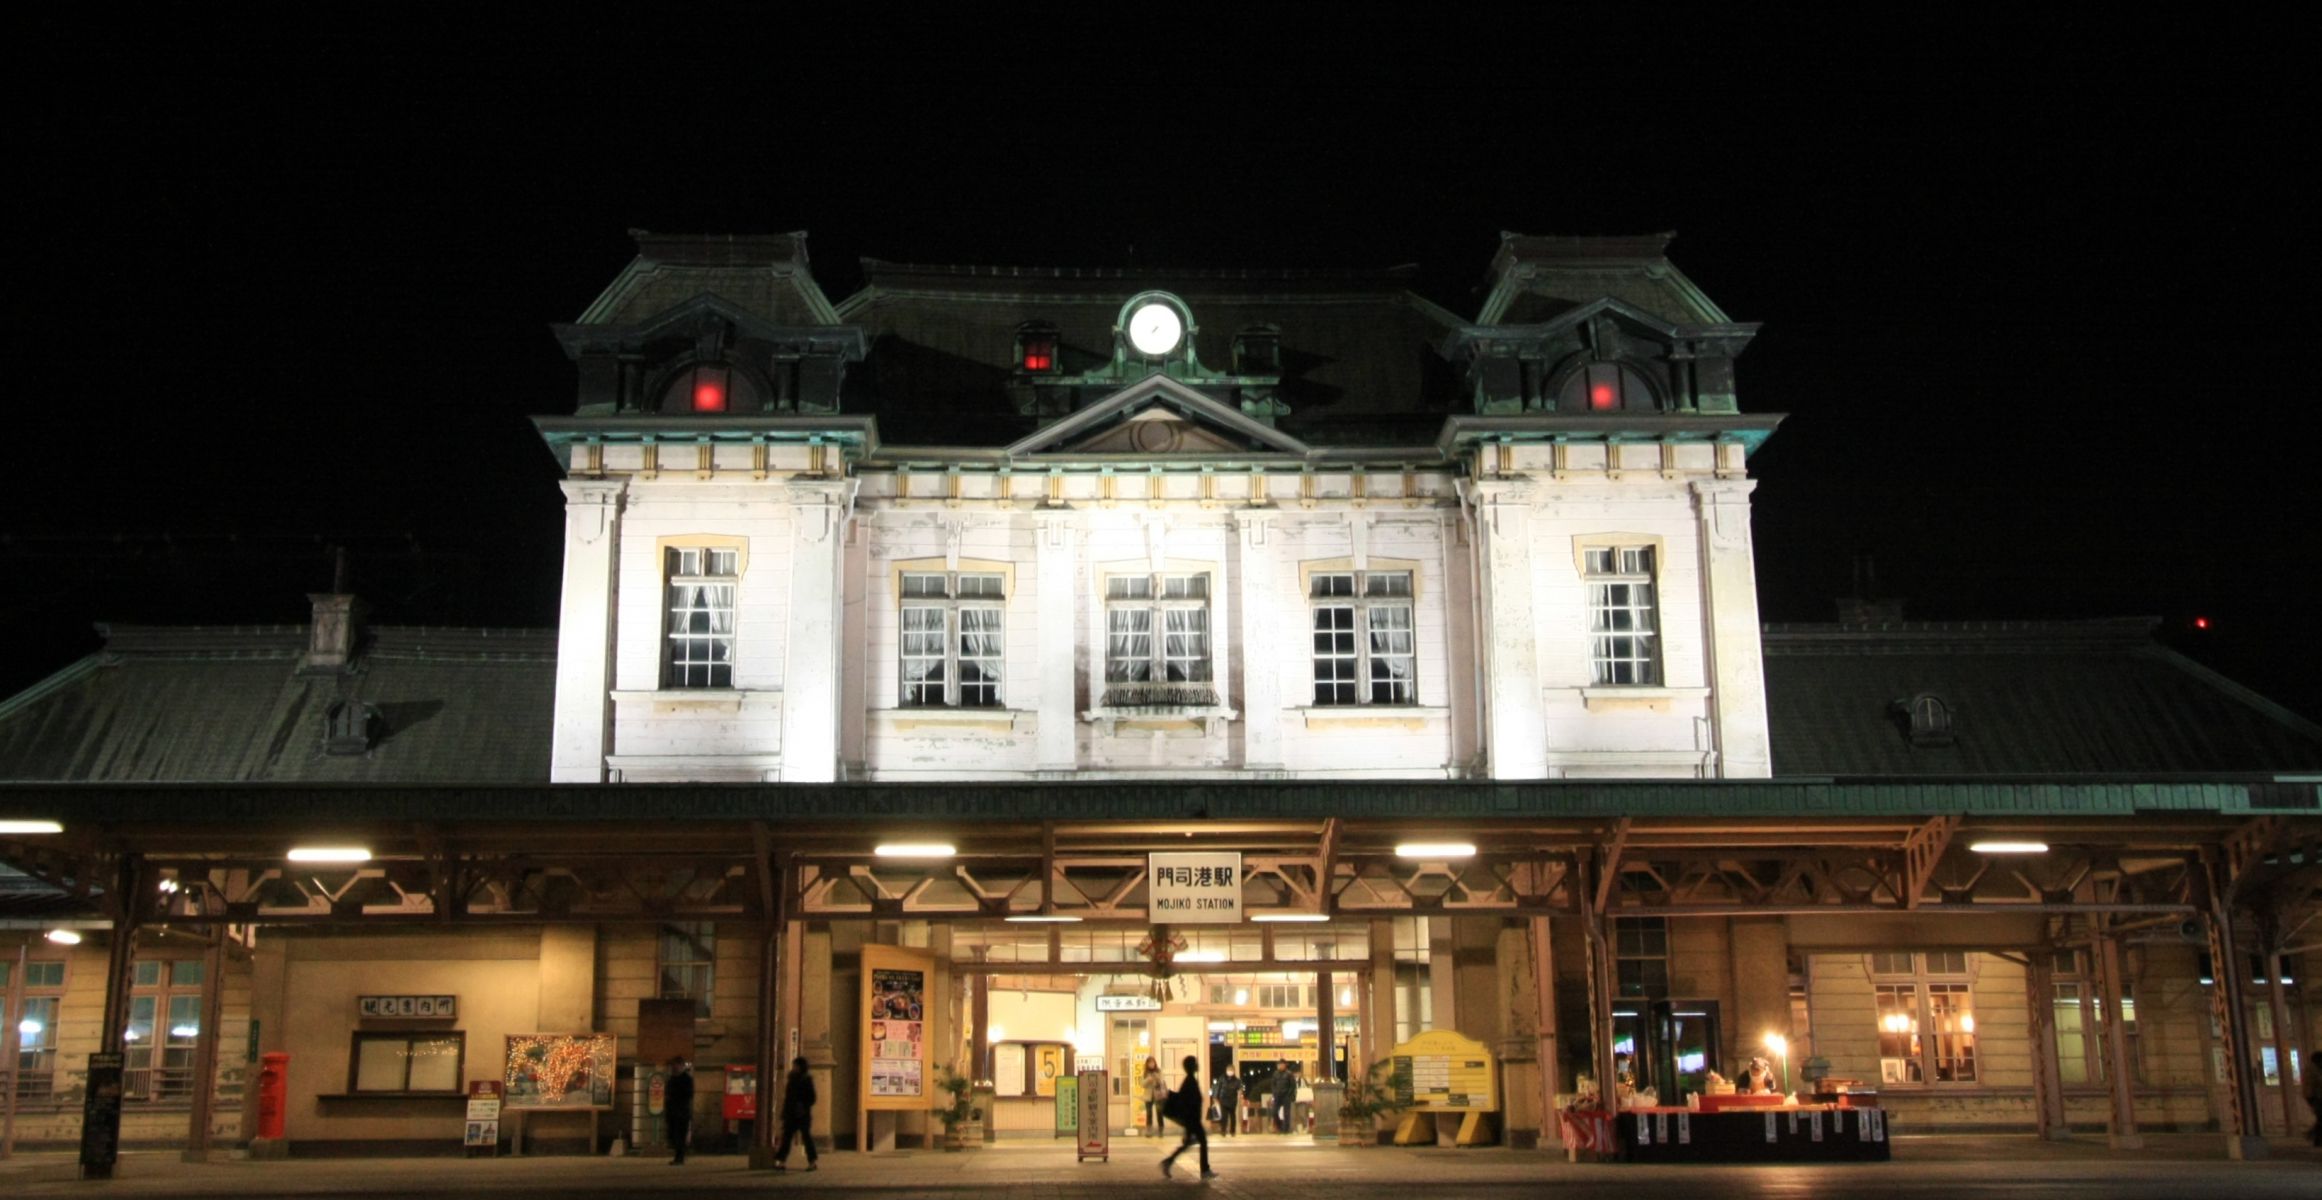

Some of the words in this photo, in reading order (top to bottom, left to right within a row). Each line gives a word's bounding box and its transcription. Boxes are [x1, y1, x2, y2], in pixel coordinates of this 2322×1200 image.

[1157, 866, 1233, 887] 門司港駅
[1197, 897, 1234, 910] STATION
[1043, 1051, 1055, 1079] 5
